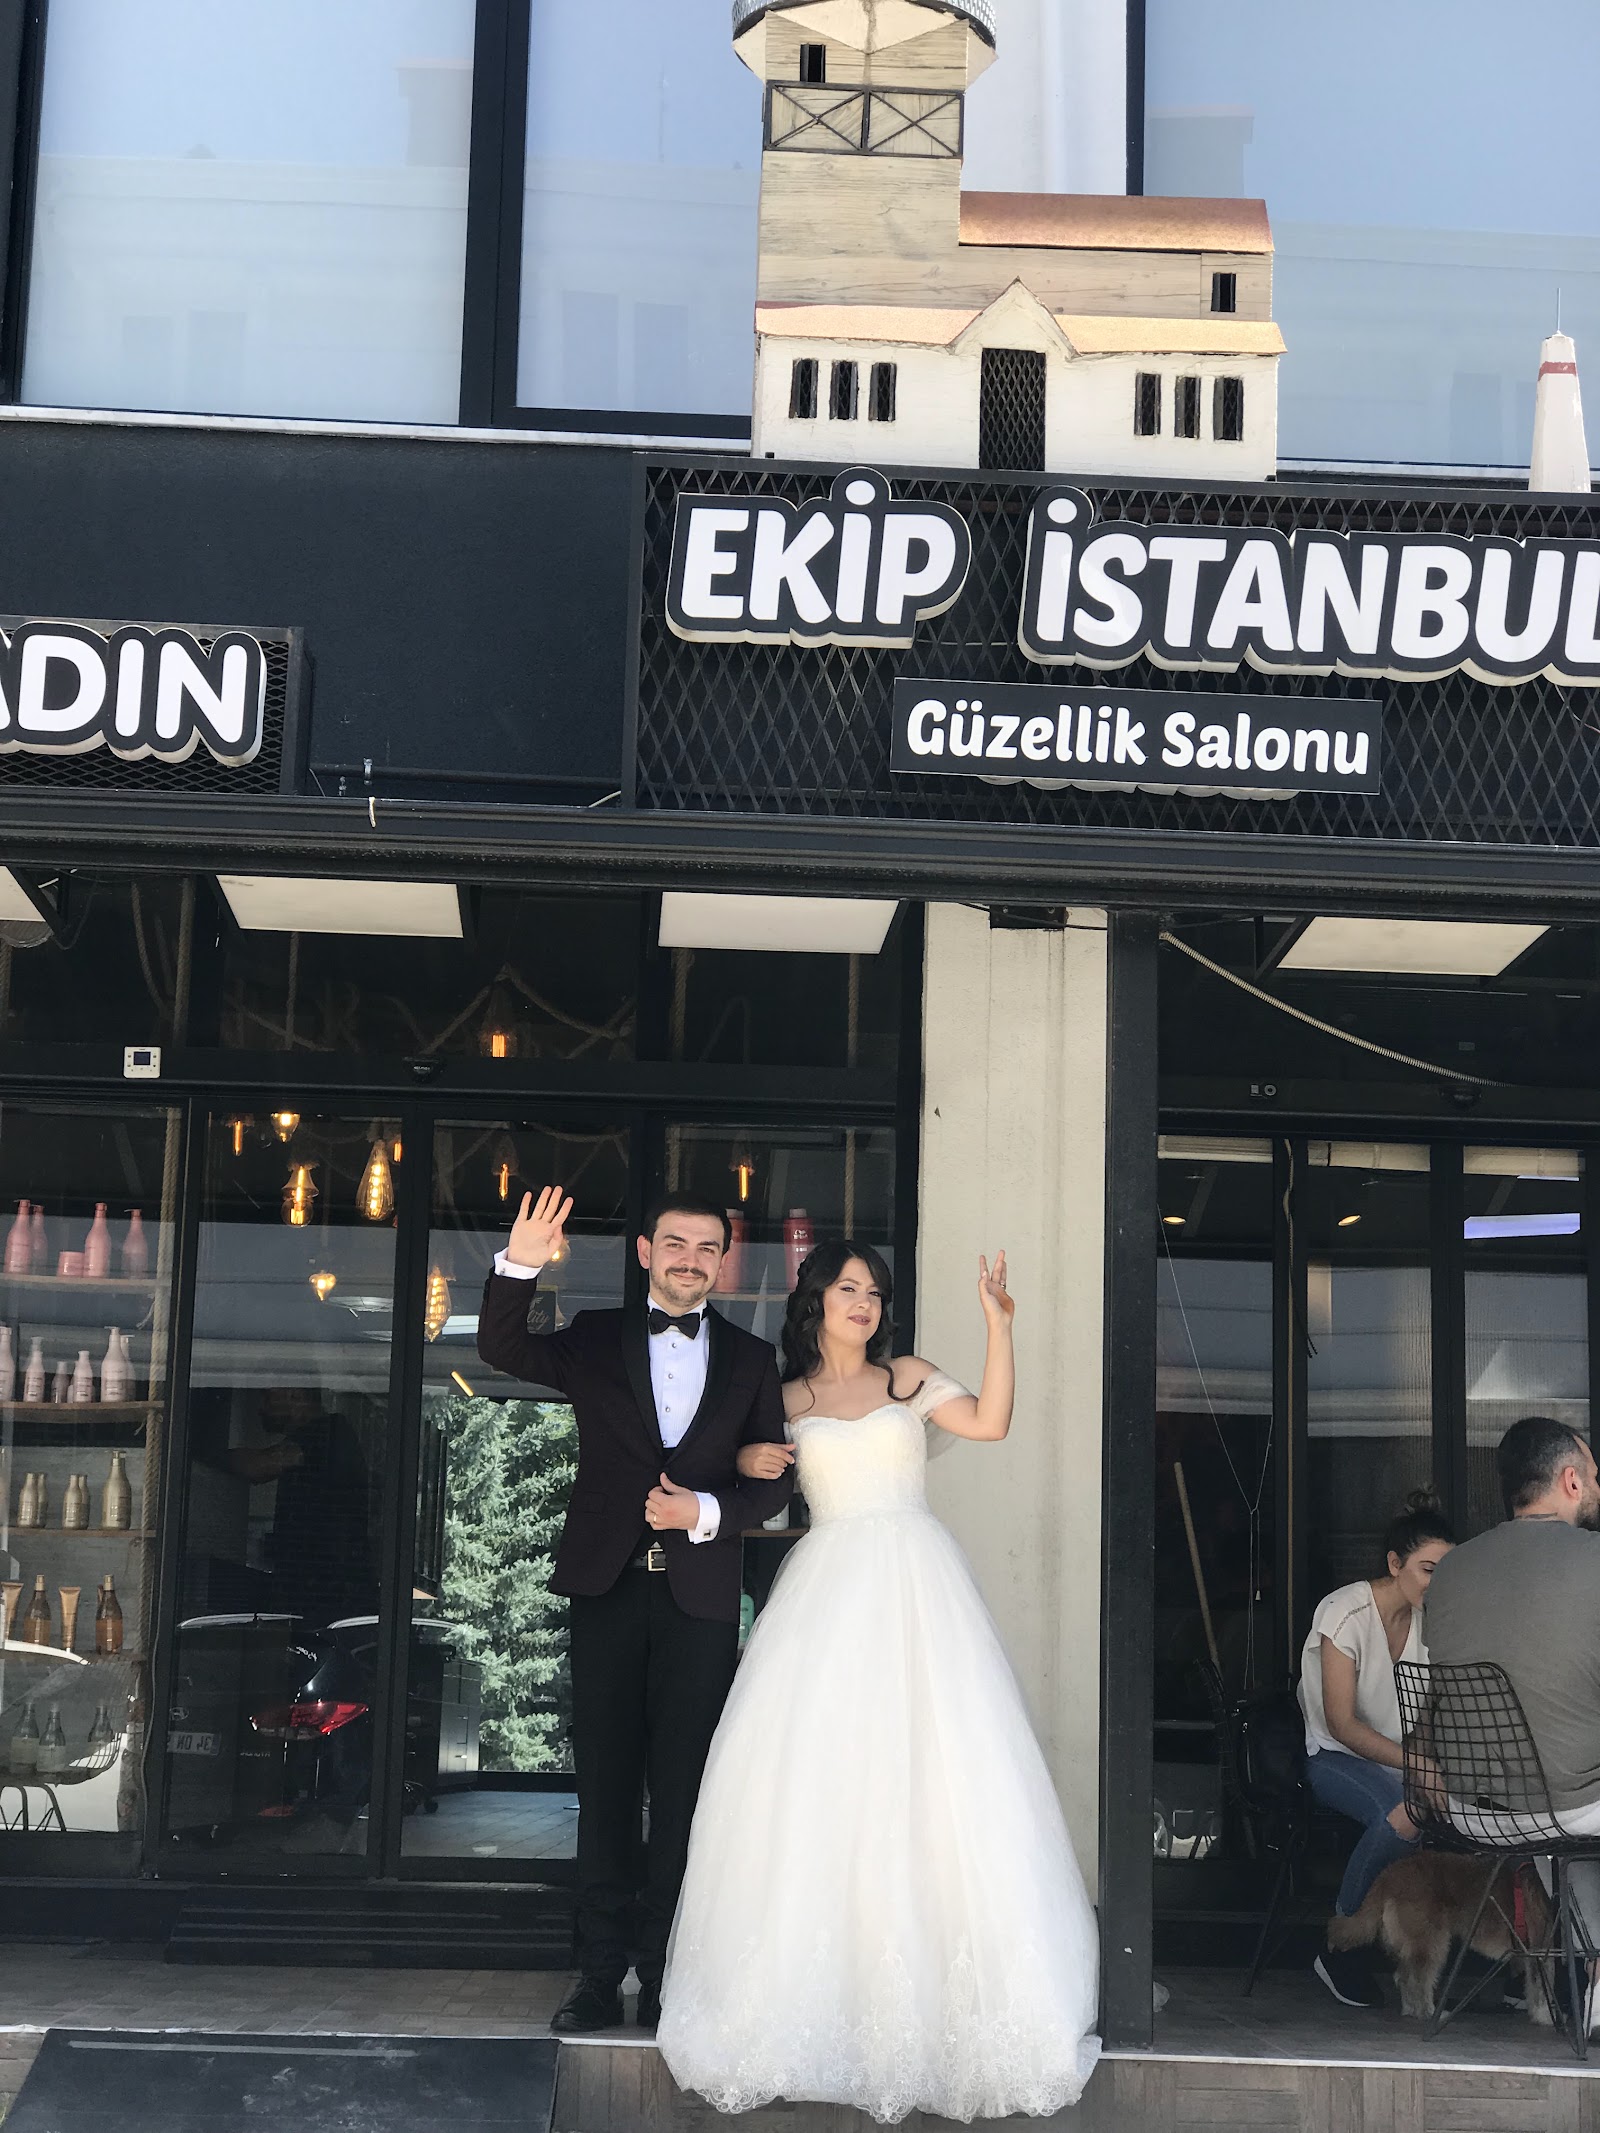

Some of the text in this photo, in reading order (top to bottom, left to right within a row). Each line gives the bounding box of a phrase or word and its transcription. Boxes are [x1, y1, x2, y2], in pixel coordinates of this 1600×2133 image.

[680, 480, 1600, 664] EKİP İSTANBUL
[0, 634, 248, 744] DIN
[906, 699, 1370, 775] Güzellik Salonu
[526, 1308, 547, 1328] lity
